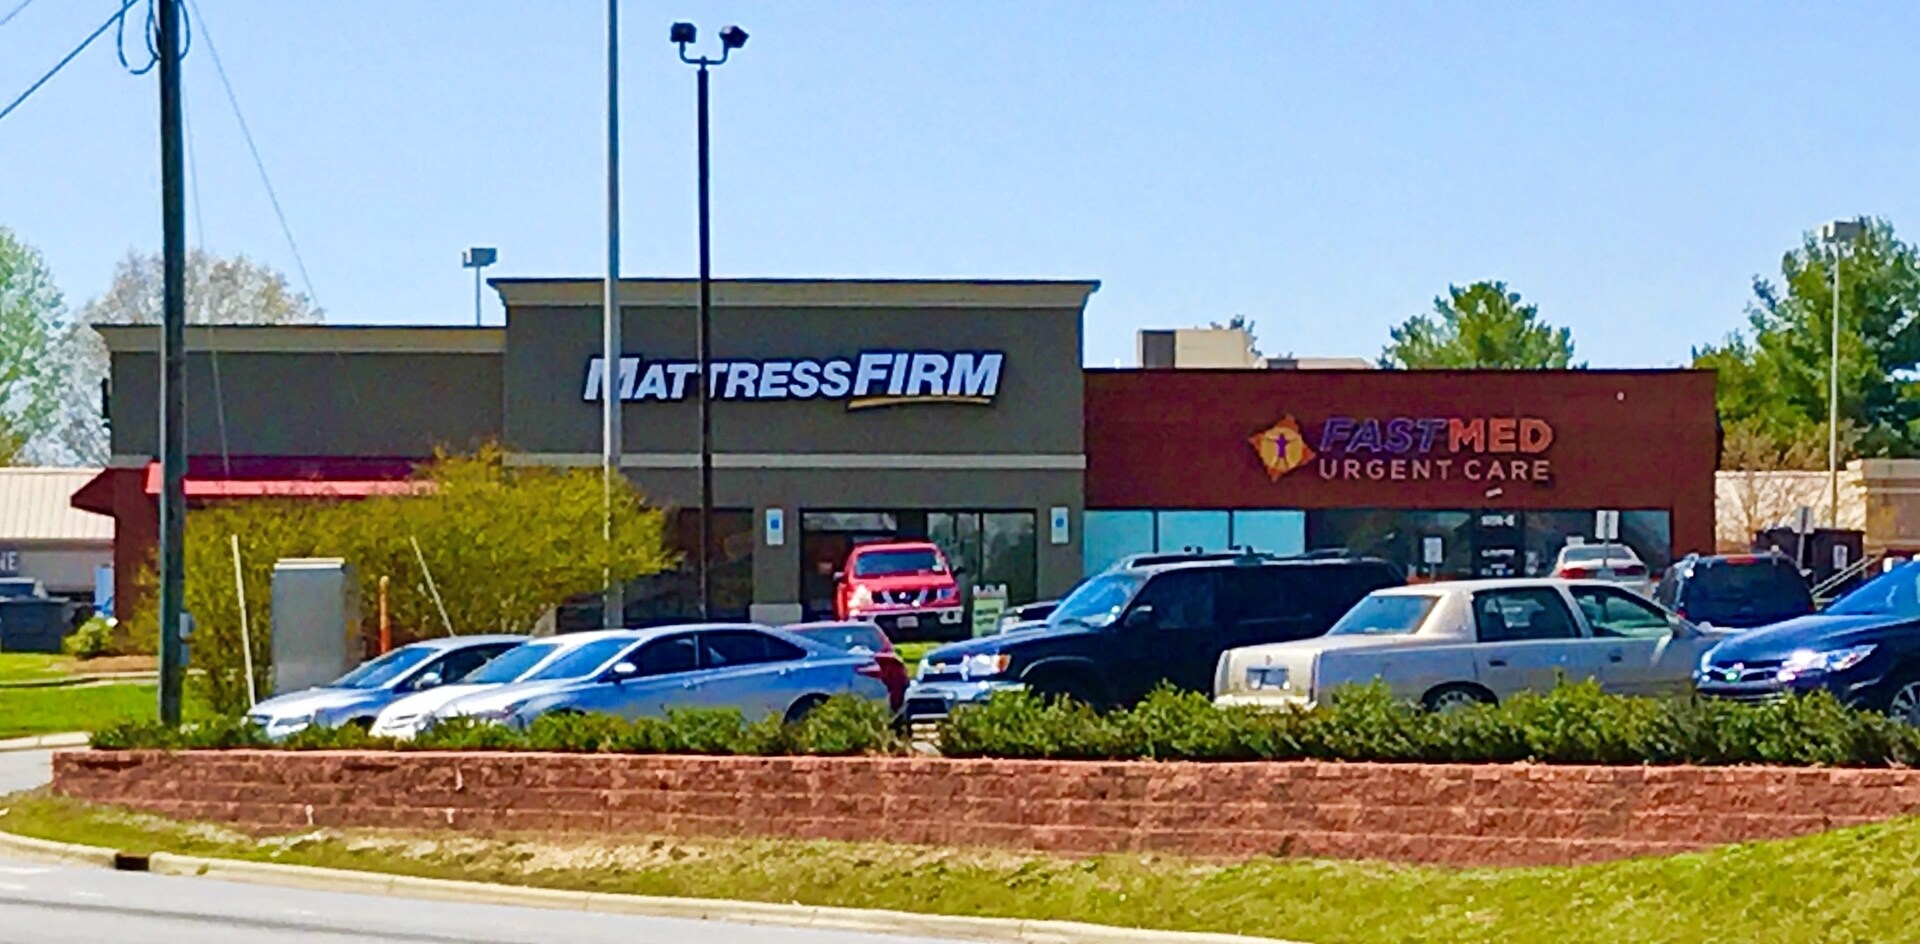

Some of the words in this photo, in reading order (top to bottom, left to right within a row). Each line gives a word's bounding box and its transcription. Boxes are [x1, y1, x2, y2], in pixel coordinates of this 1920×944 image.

[1319, 417, 1553, 453] FASTMED
[1319, 459, 1453, 480] URGENT
[1464, 460, 1550, 481] CARE
